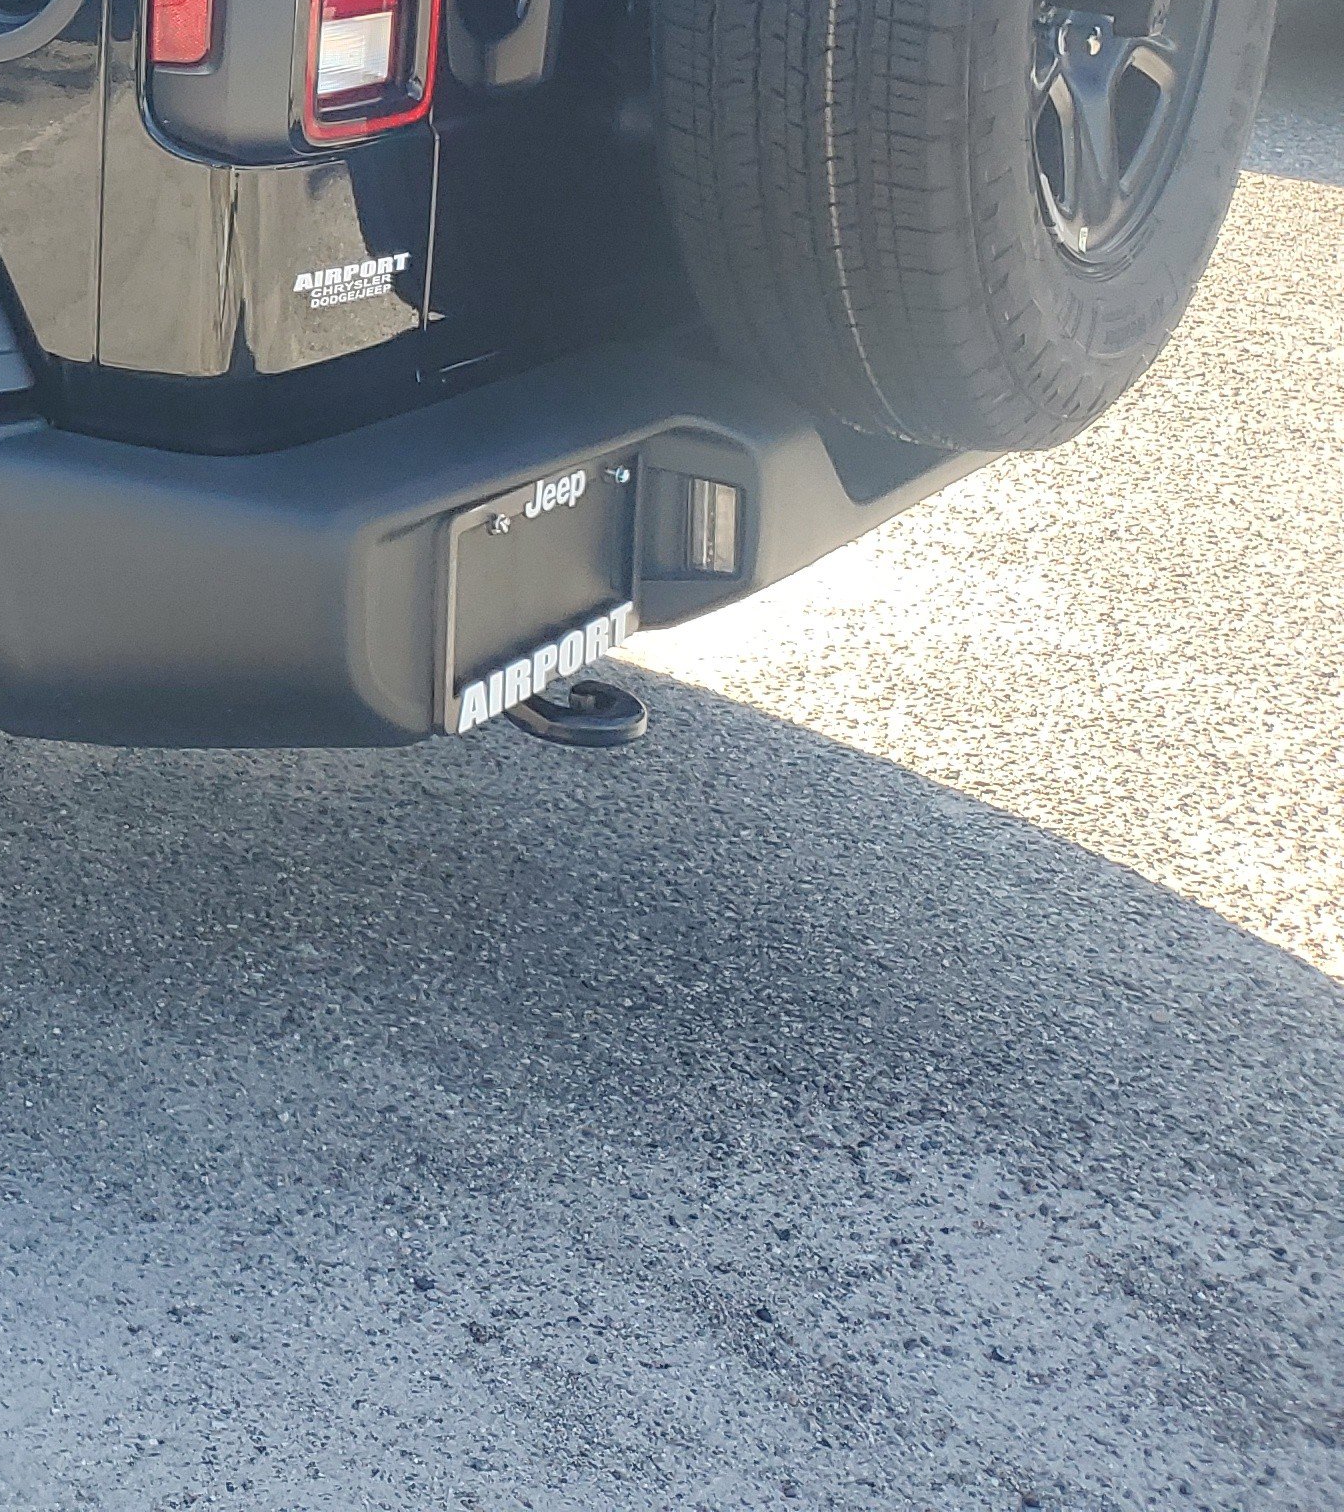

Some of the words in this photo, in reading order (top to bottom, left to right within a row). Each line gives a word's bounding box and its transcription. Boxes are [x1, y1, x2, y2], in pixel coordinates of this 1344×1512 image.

[293, 252, 411, 292] AIRPORT
[311, 273, 392, 298] CHRYSLER
[310, 283, 392, 308] DODGE/JEEP
[525, 469, 586, 519] Jeep
[458, 600, 634, 734] AIRPORT
